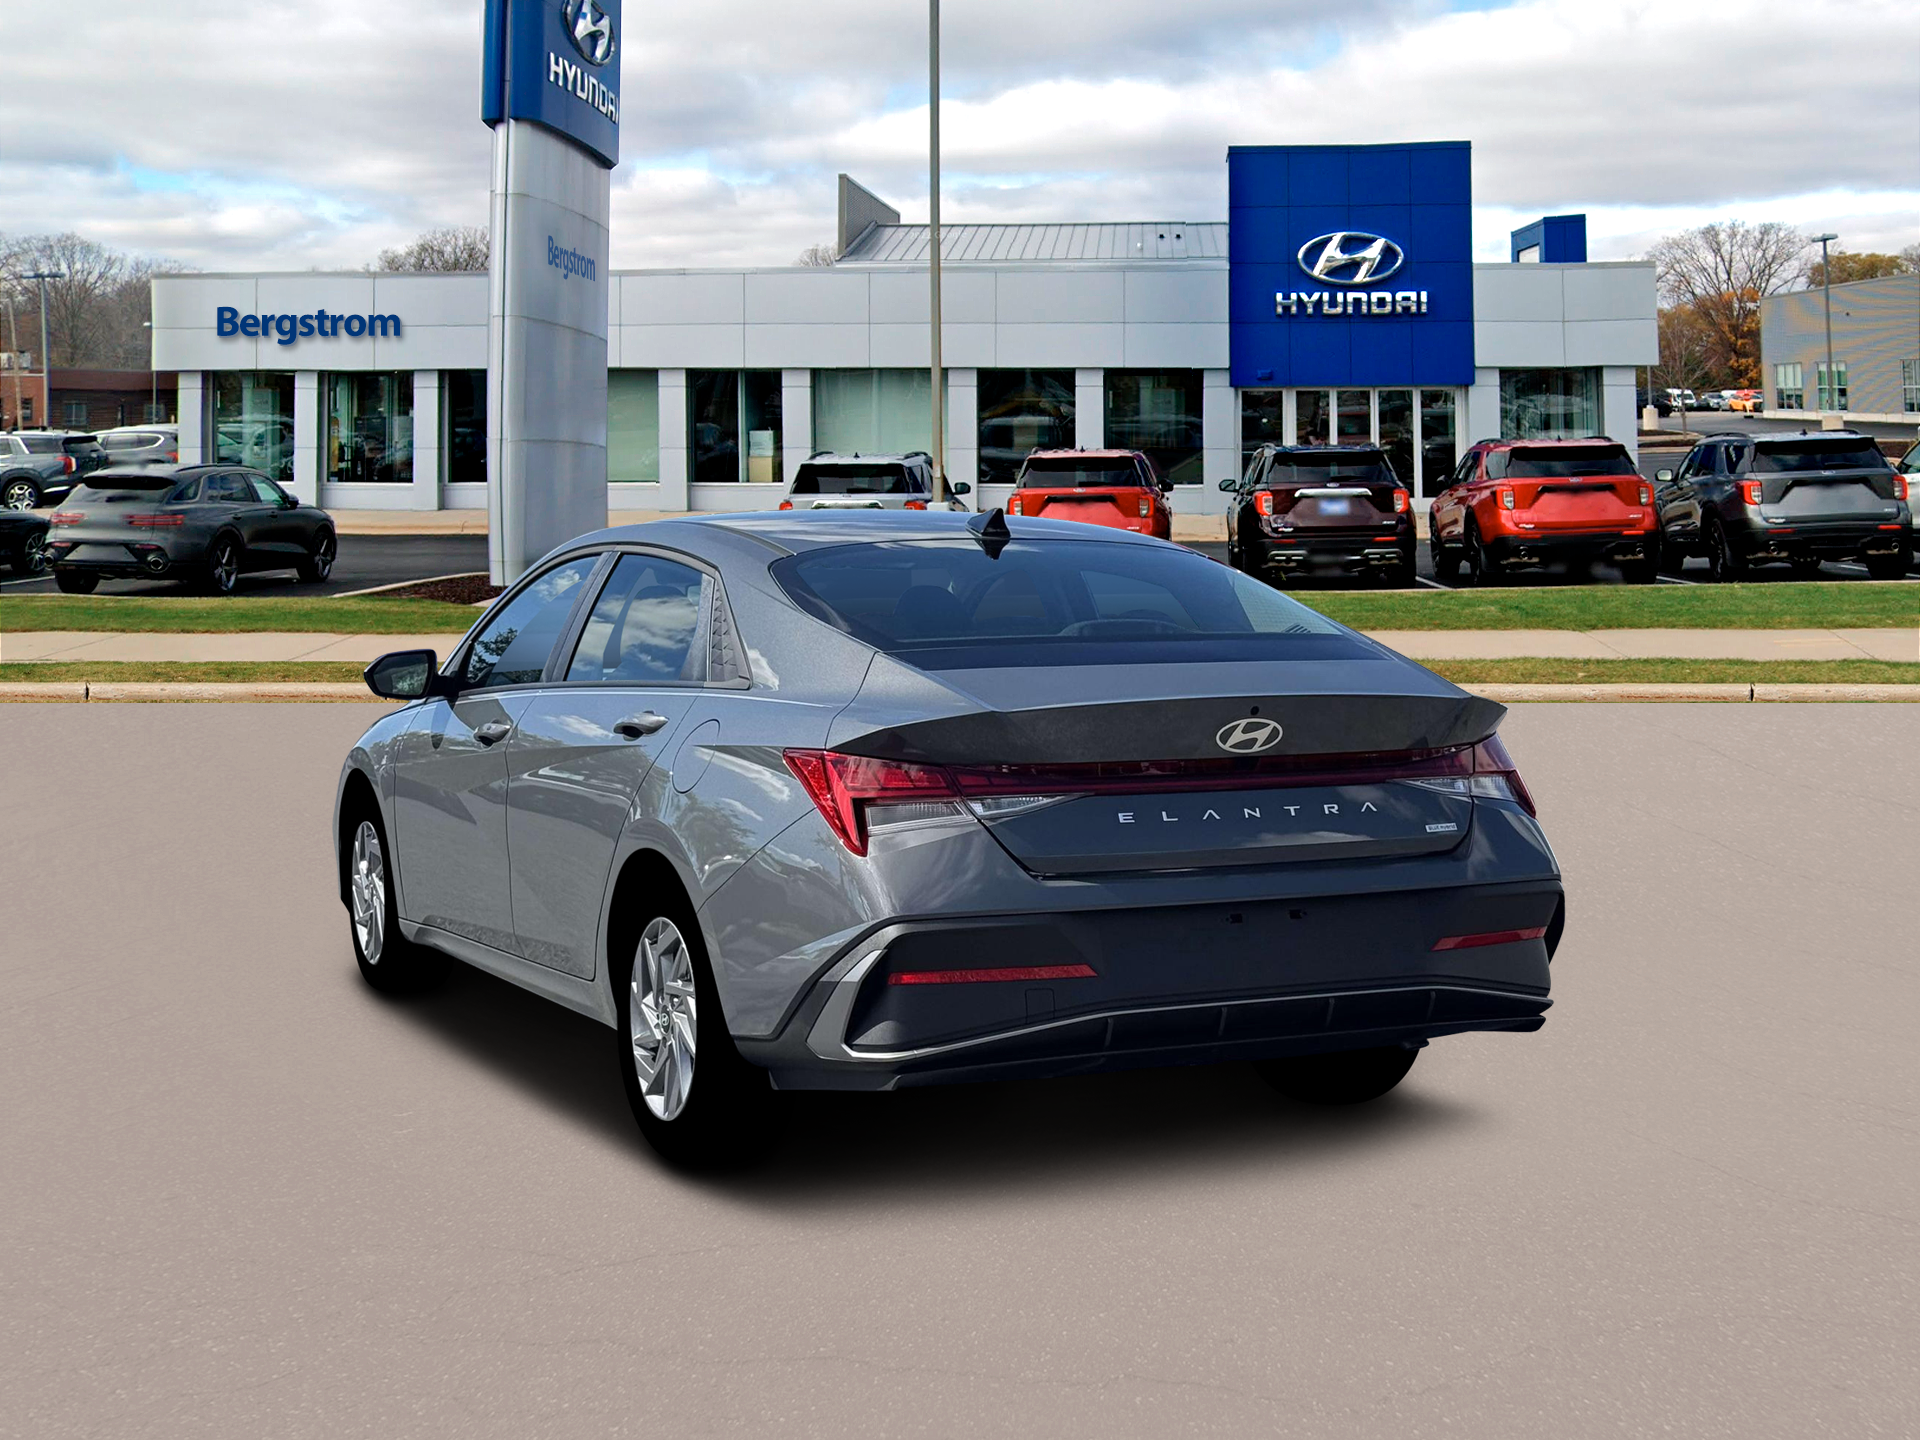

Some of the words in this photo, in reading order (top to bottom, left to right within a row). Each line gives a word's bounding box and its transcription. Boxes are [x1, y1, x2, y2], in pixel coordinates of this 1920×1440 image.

[549, 52, 619, 124] HYUNDAI
[548, 235, 596, 282] Bergstrom
[1275, 290, 1428, 315] HYUNDAI
[216, 306, 401, 346] Bergstrom
[1117, 801, 1378, 824] ELANTRA
